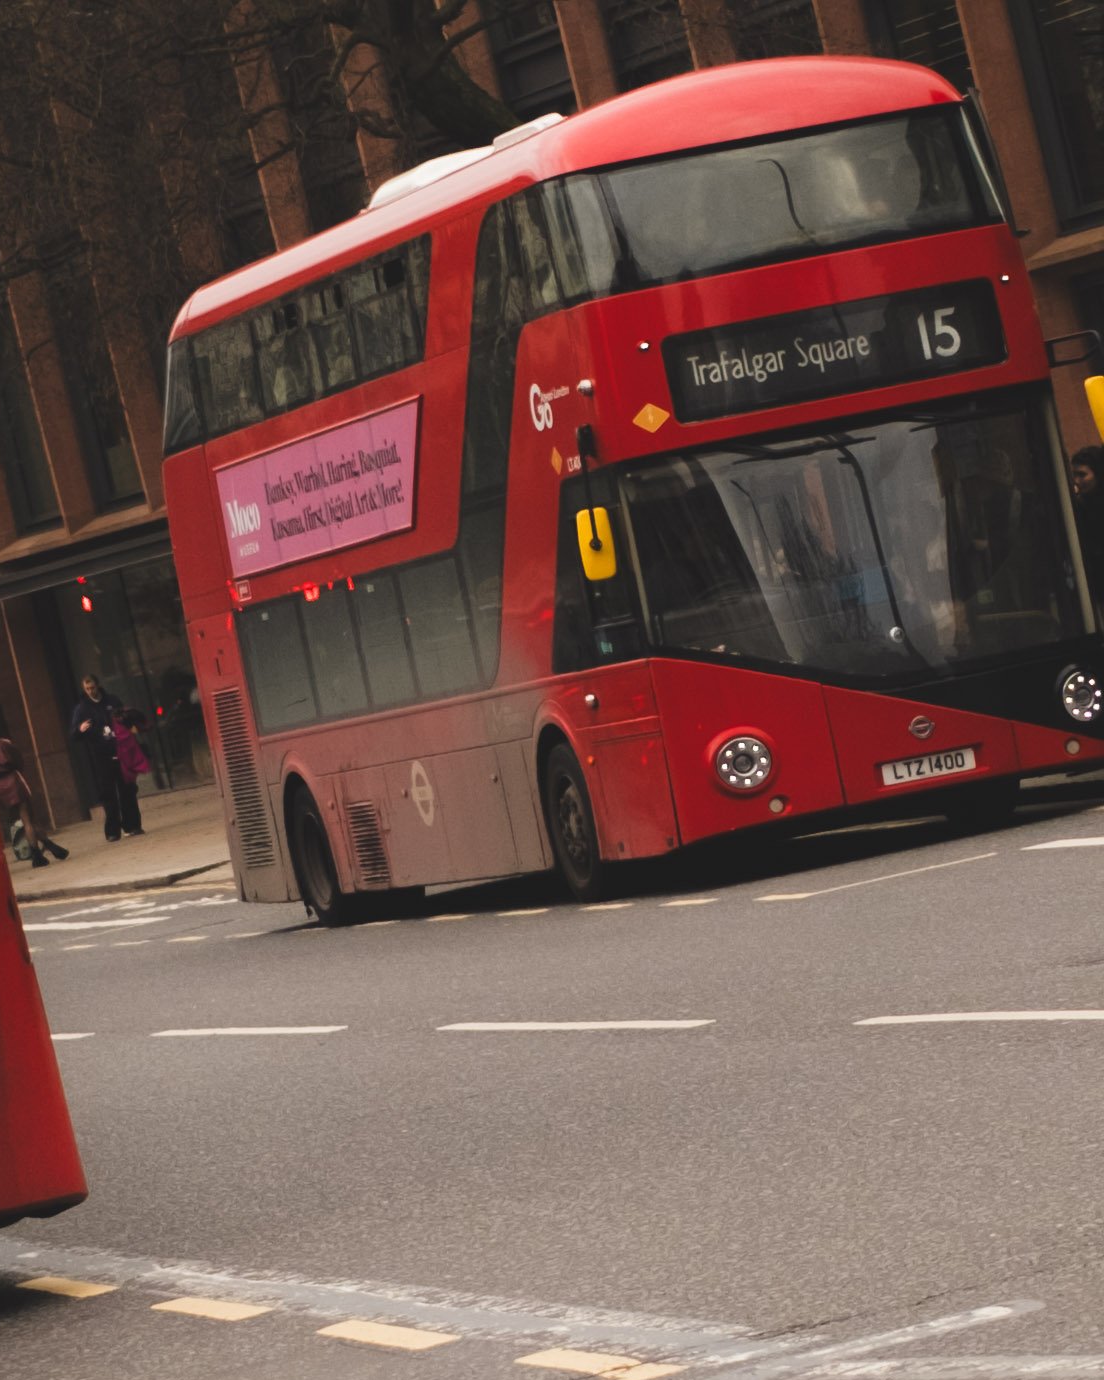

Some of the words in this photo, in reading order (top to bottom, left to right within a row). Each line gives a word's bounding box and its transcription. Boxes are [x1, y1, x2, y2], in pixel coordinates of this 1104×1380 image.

[687, 348, 786, 386] Trafalgar
[794, 335, 871, 373] Square
[917, 306, 961, 361] 15
[225, 498, 261, 539] Moco
